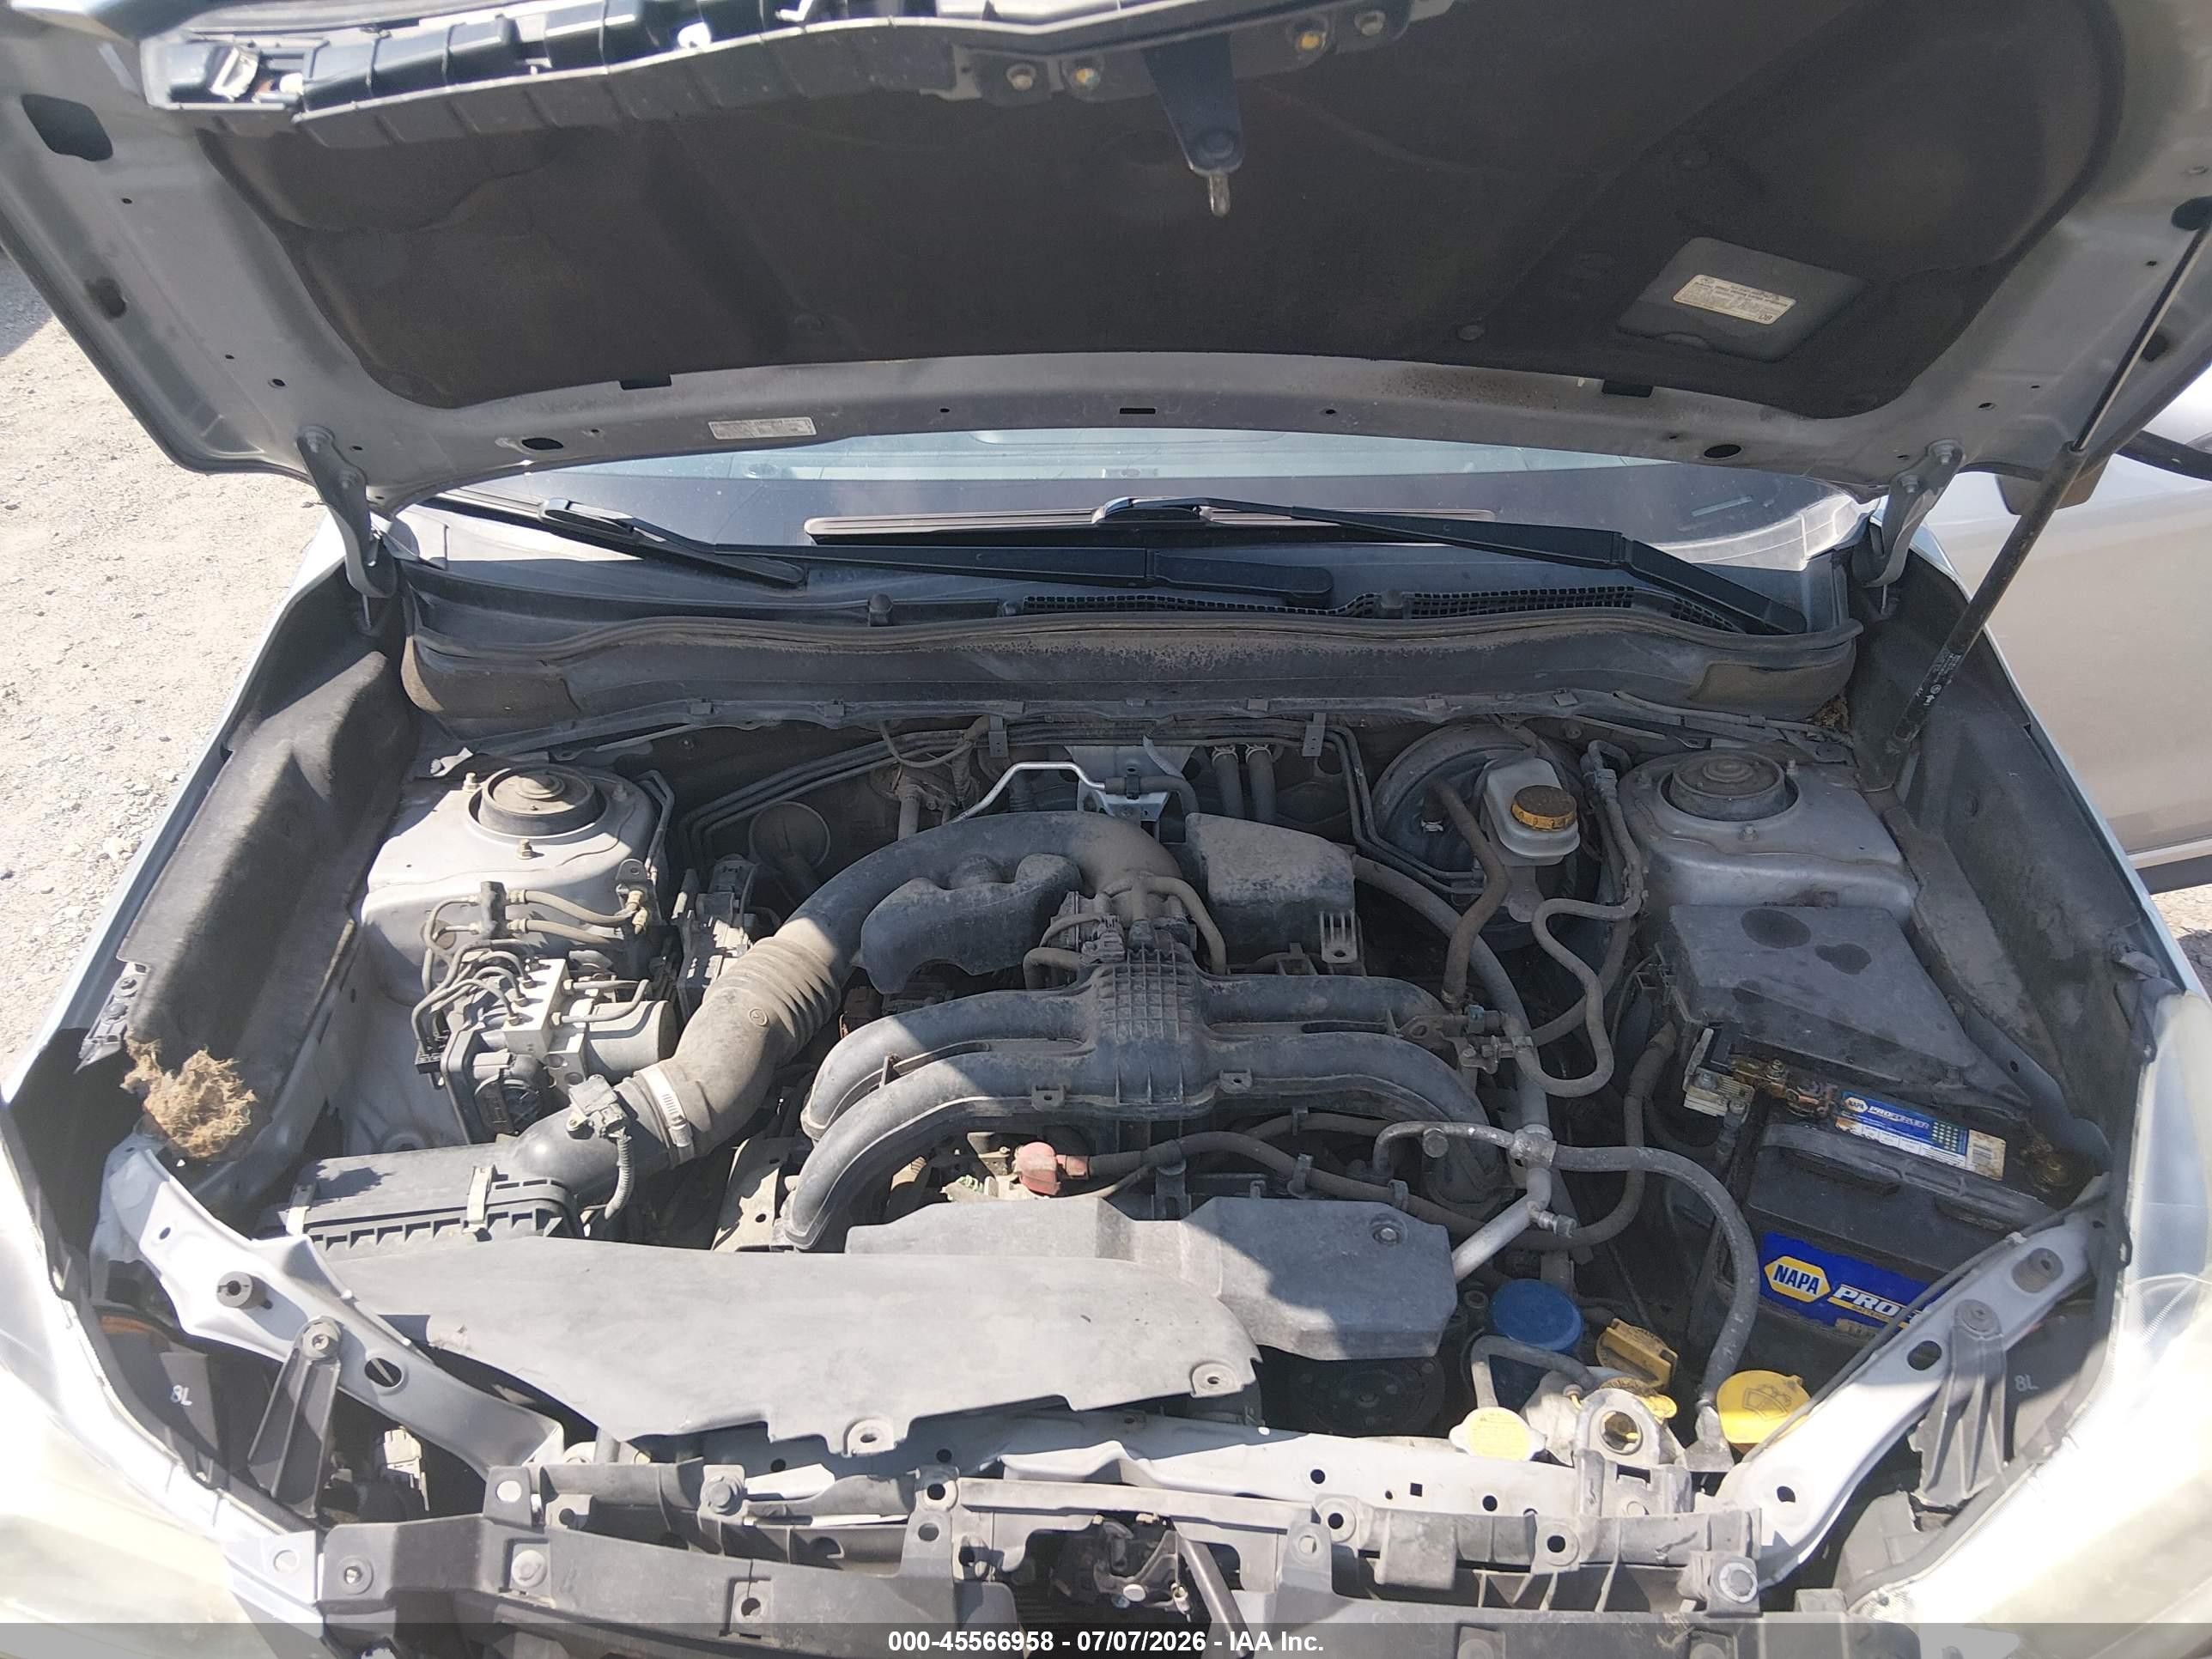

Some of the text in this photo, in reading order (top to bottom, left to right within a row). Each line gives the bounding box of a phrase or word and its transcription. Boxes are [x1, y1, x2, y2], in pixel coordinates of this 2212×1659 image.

[1772, 1264, 1903, 1317] NAPA PRO
[2014, 1375, 2039, 1392] 8L
